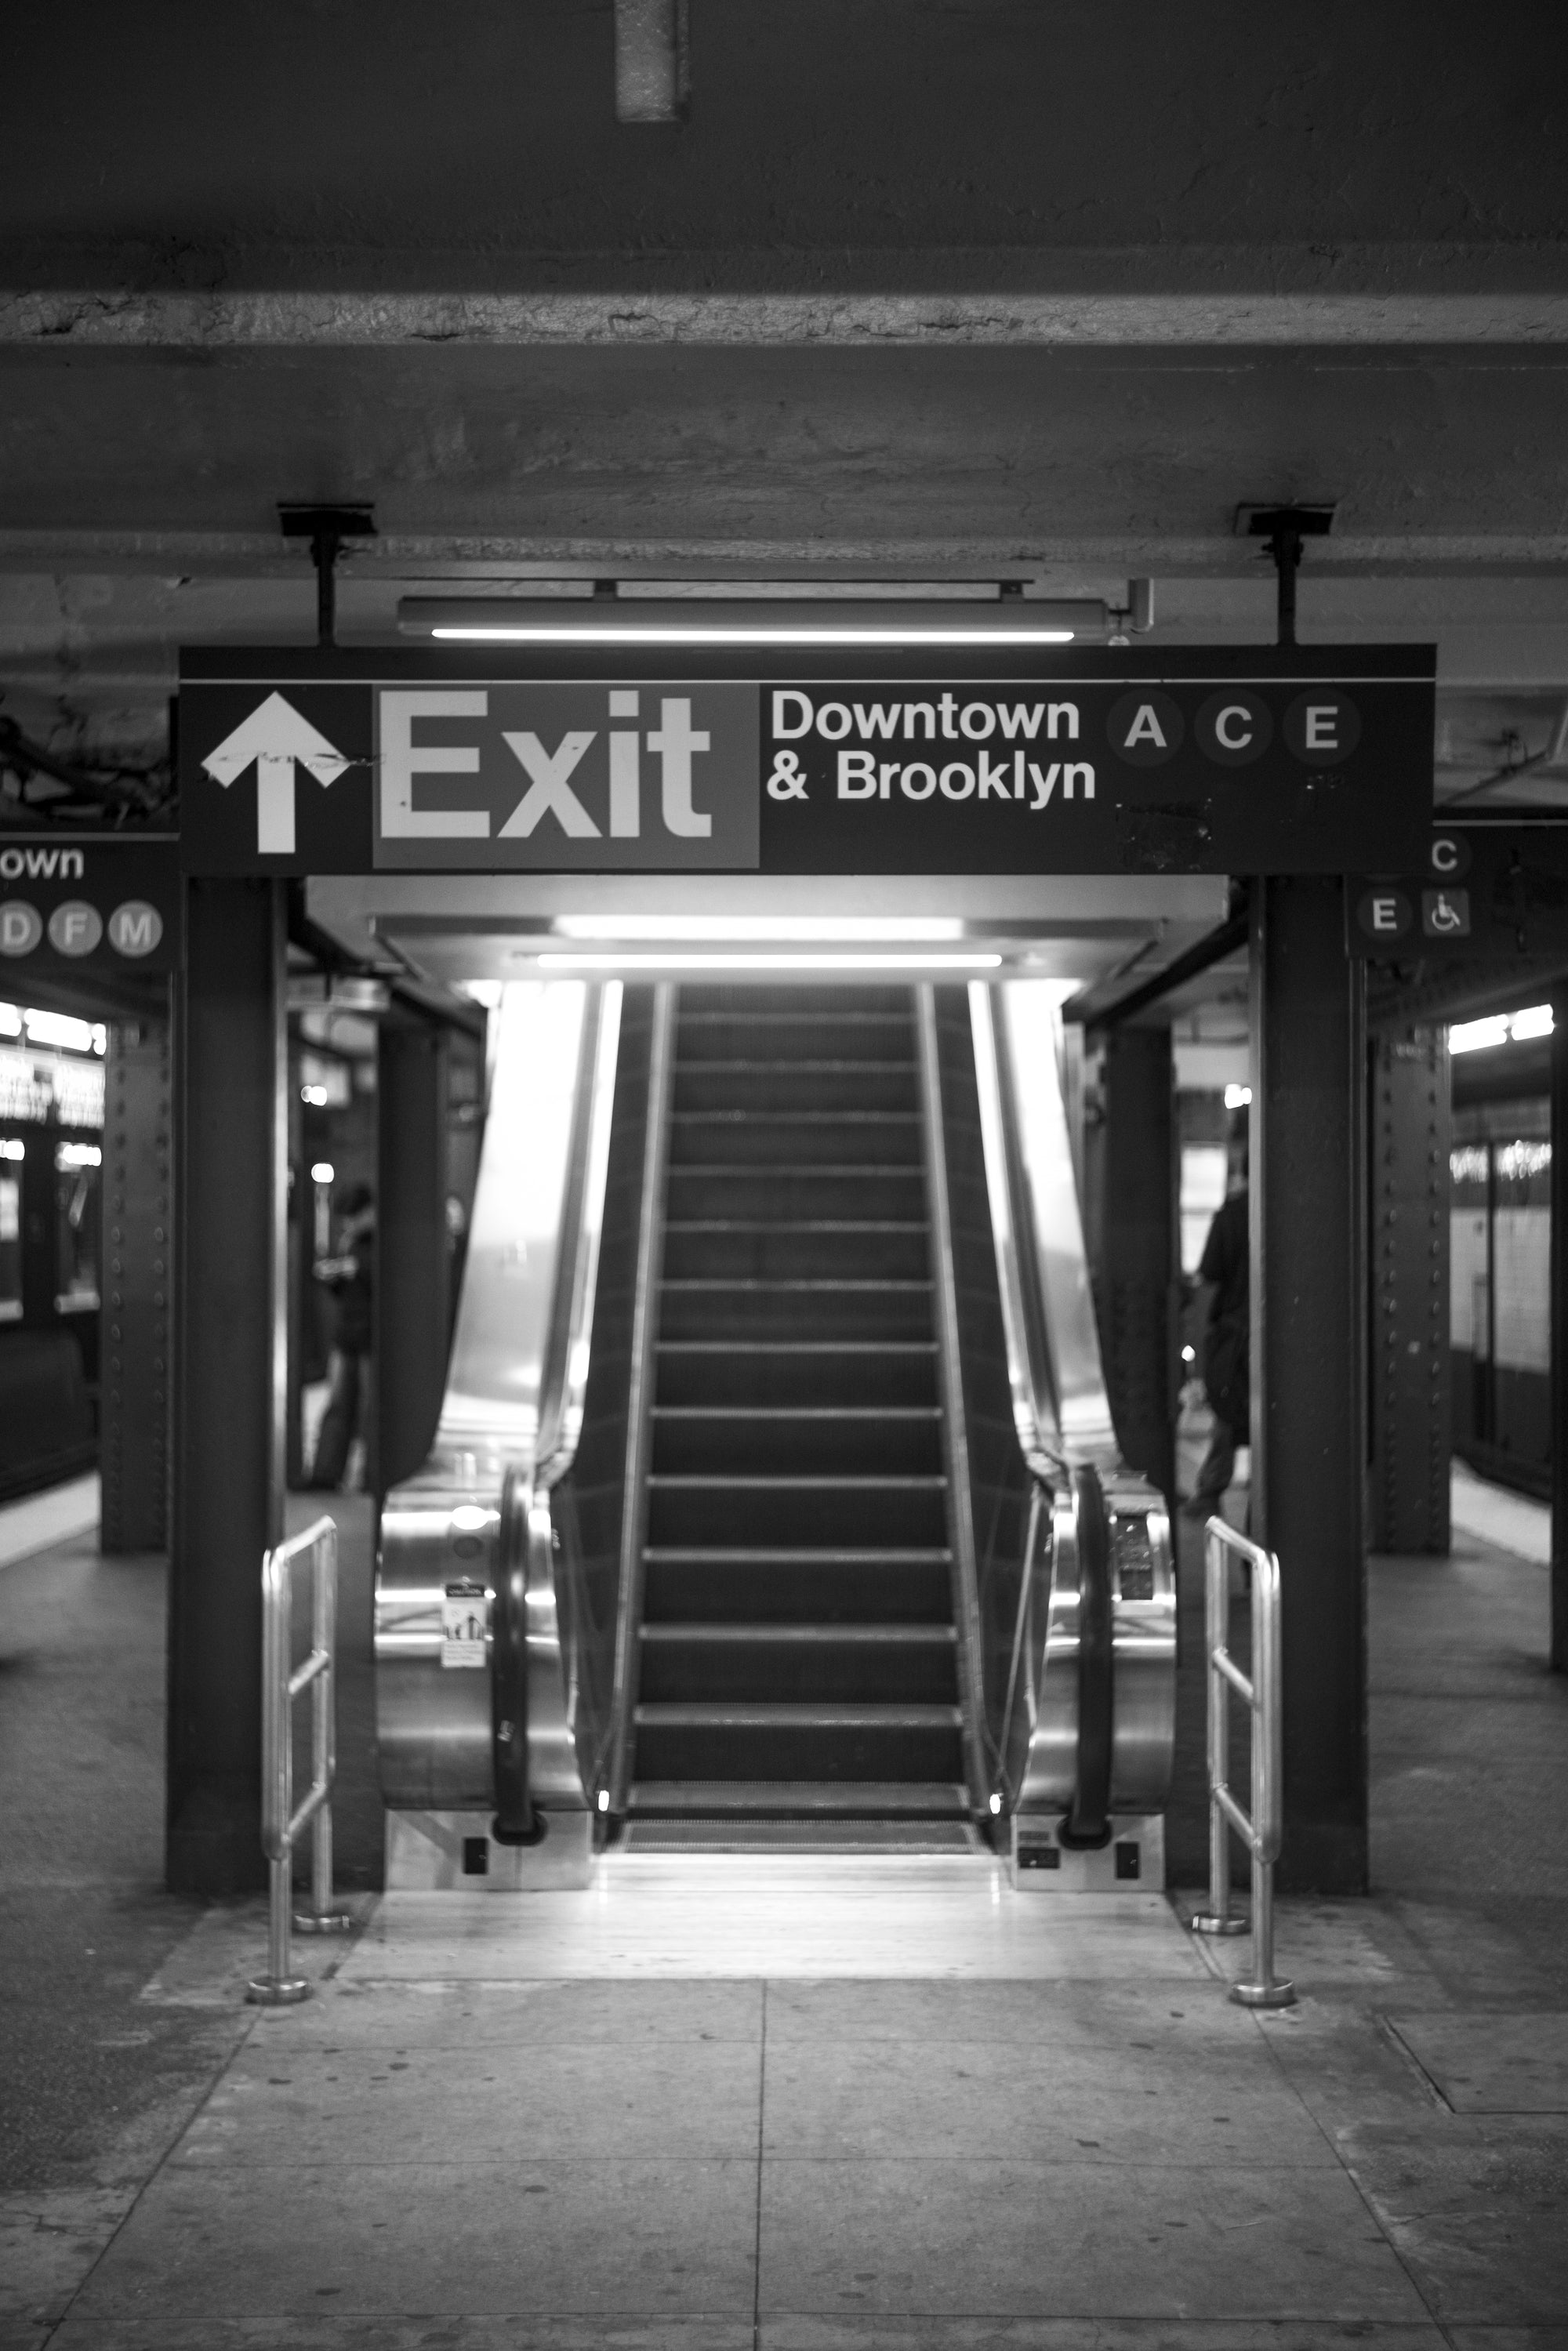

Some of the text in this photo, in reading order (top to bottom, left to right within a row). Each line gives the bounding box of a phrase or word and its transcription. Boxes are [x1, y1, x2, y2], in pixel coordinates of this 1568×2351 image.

[772, 690, 1338, 749] Downtown A C E
[380, 690, 712, 838] Exit
[767, 749, 1095, 810] & Brooklyn
[0, 847, 85, 880] own
[1432, 839, 1458, 871] C
[2, 912, 152, 946] D F M
[1373, 898, 1397, 930] E
